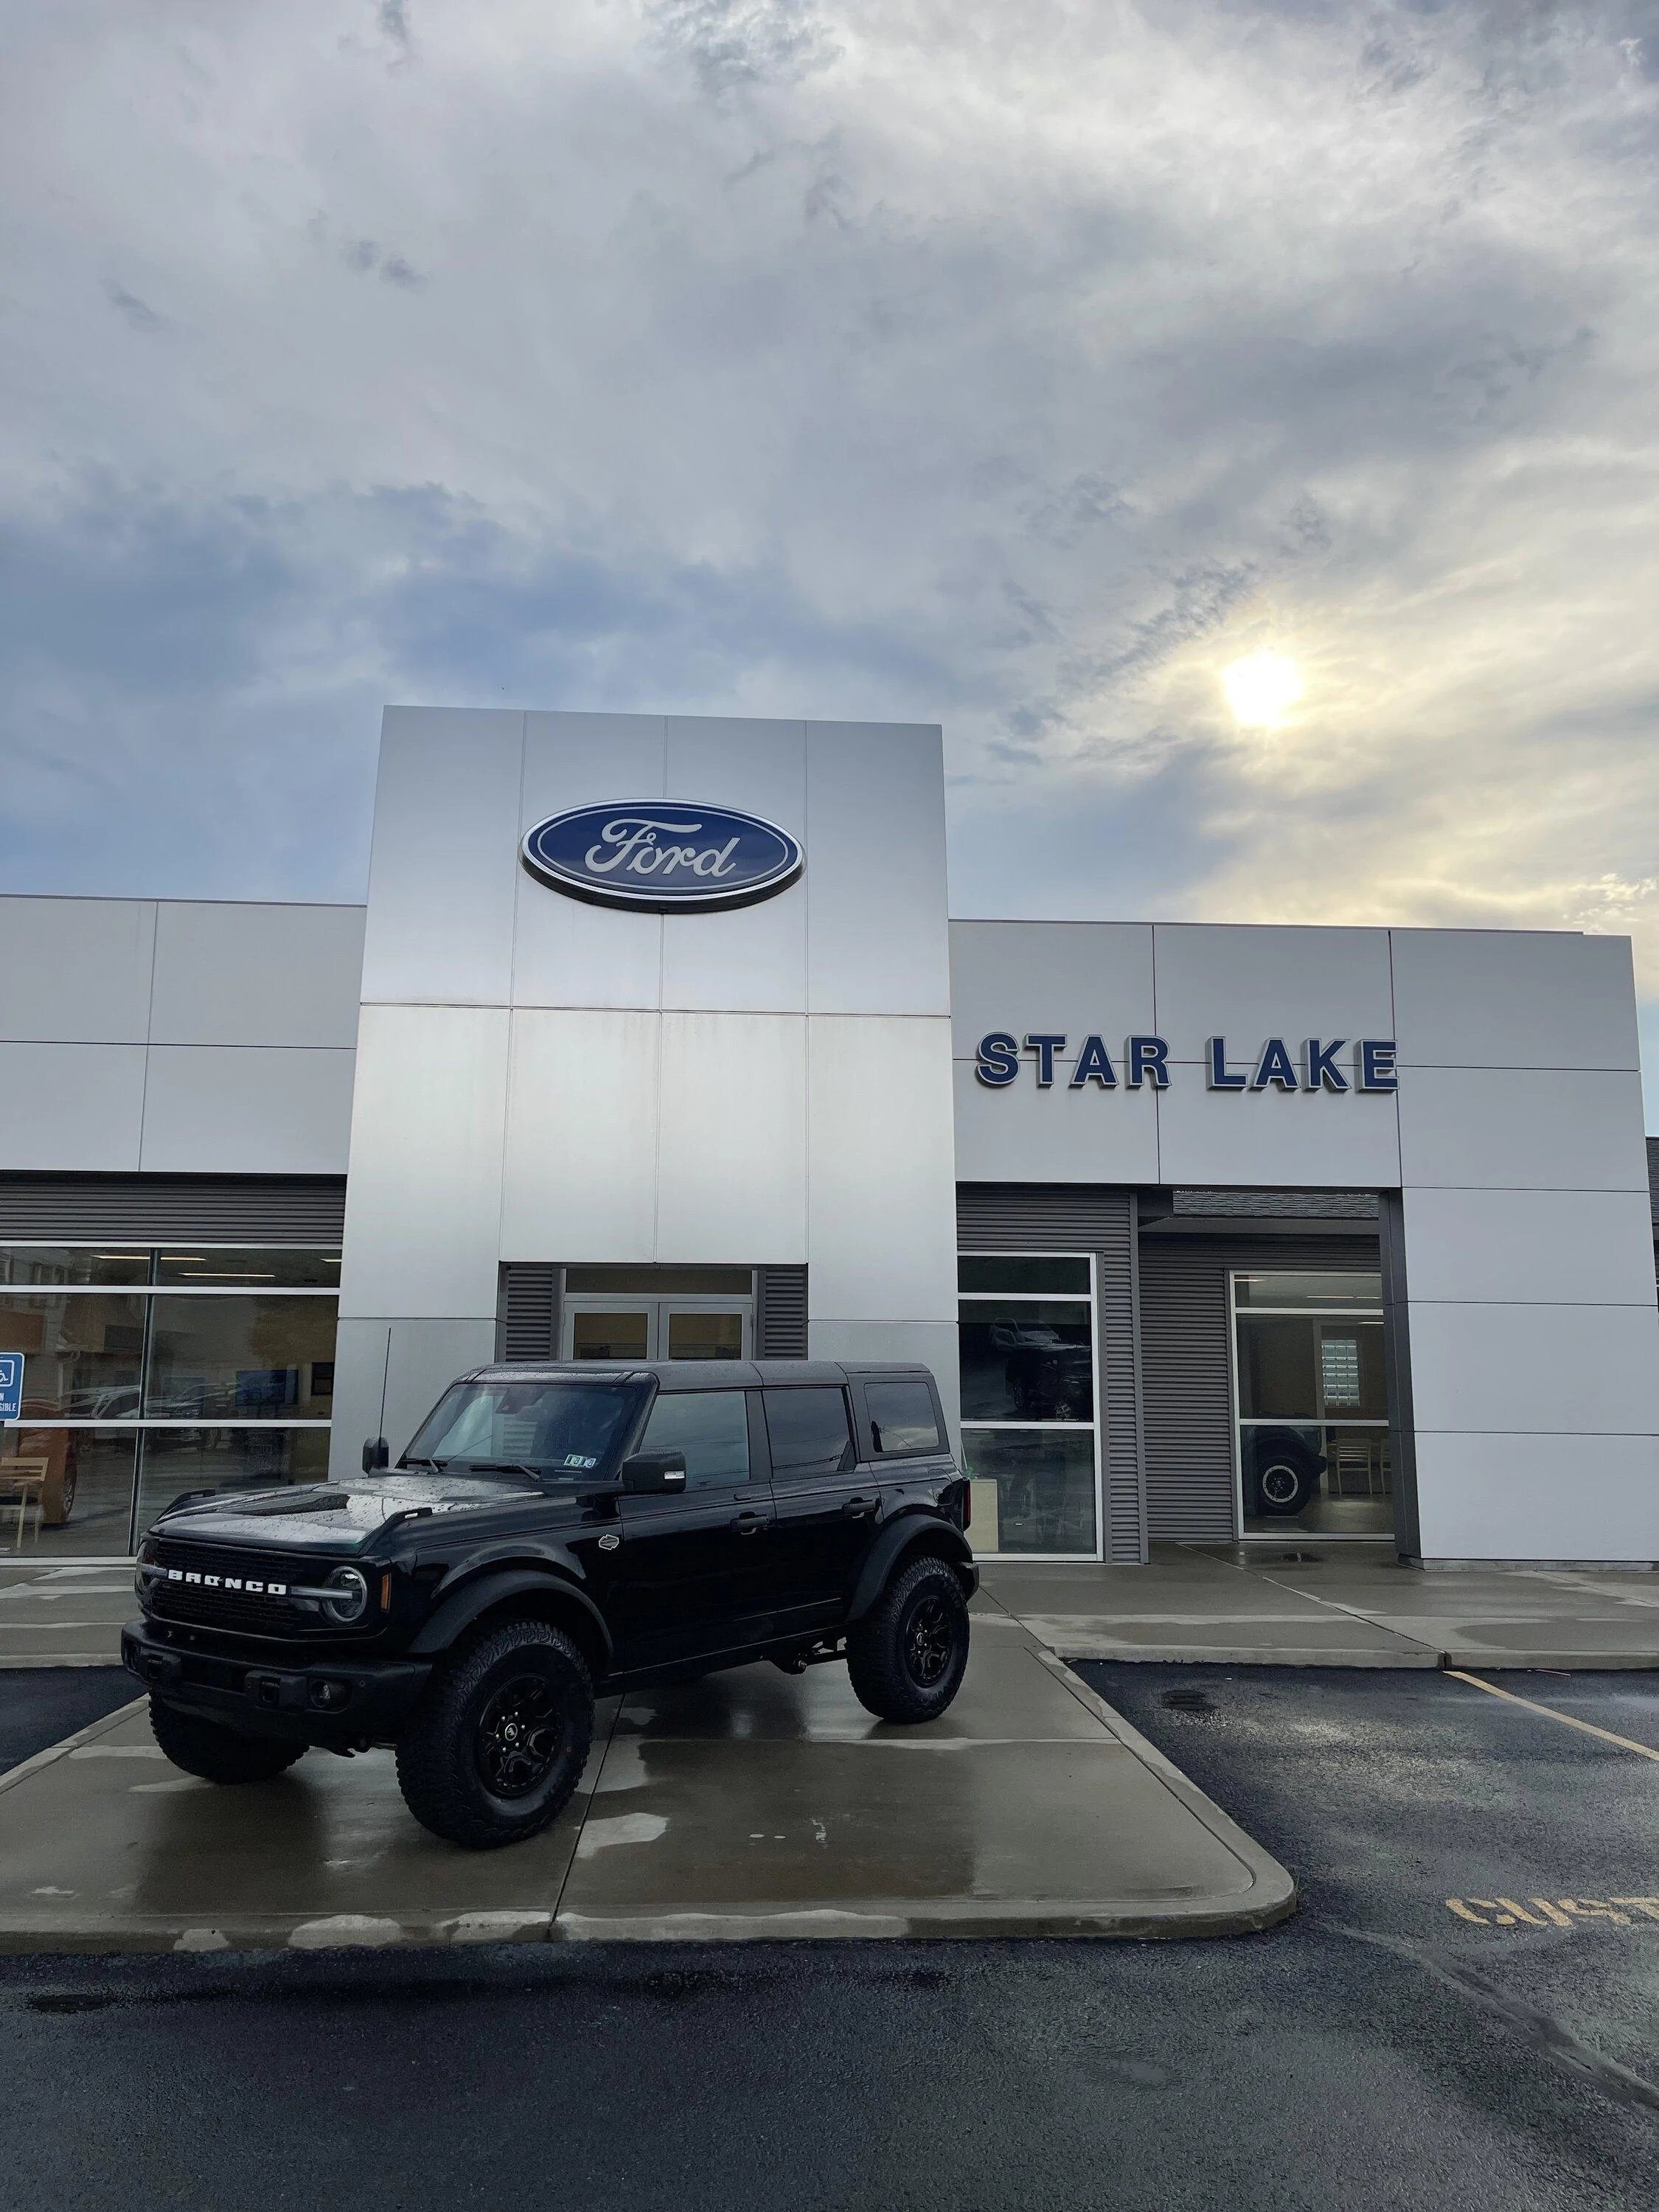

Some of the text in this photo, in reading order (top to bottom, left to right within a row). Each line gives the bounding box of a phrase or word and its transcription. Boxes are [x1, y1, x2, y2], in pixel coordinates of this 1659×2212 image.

[585, 818, 740, 877] Ford
[975, 1032, 1400, 1093] STAR LAKE
[168, 1569, 287, 1595] BRONCO
